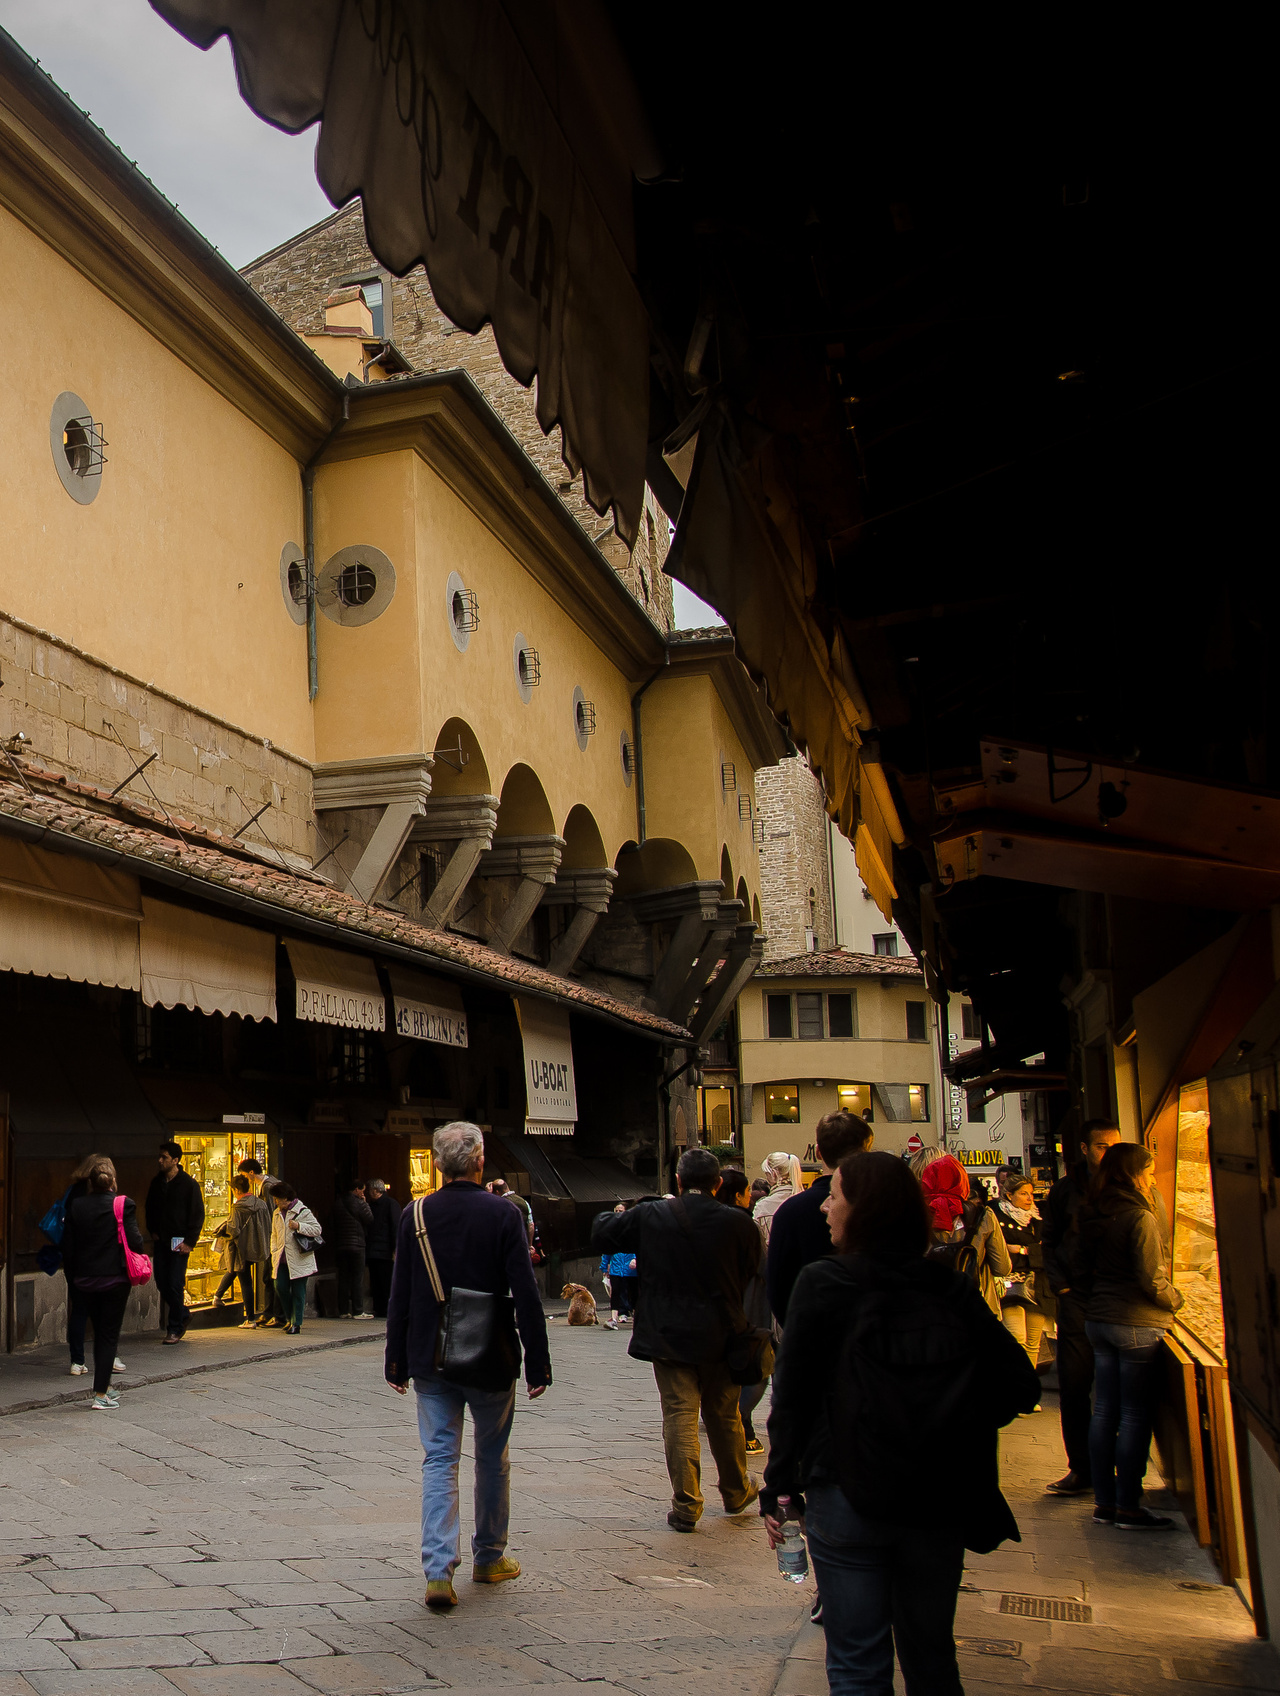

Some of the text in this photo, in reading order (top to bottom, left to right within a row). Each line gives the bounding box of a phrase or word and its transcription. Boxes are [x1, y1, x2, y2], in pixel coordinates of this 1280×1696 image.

[412, 1012, 452, 1043] BELLINI
[531, 1060, 568, 1092] U-BOAT
[959, 1150, 1005, 1166] MADOVA
